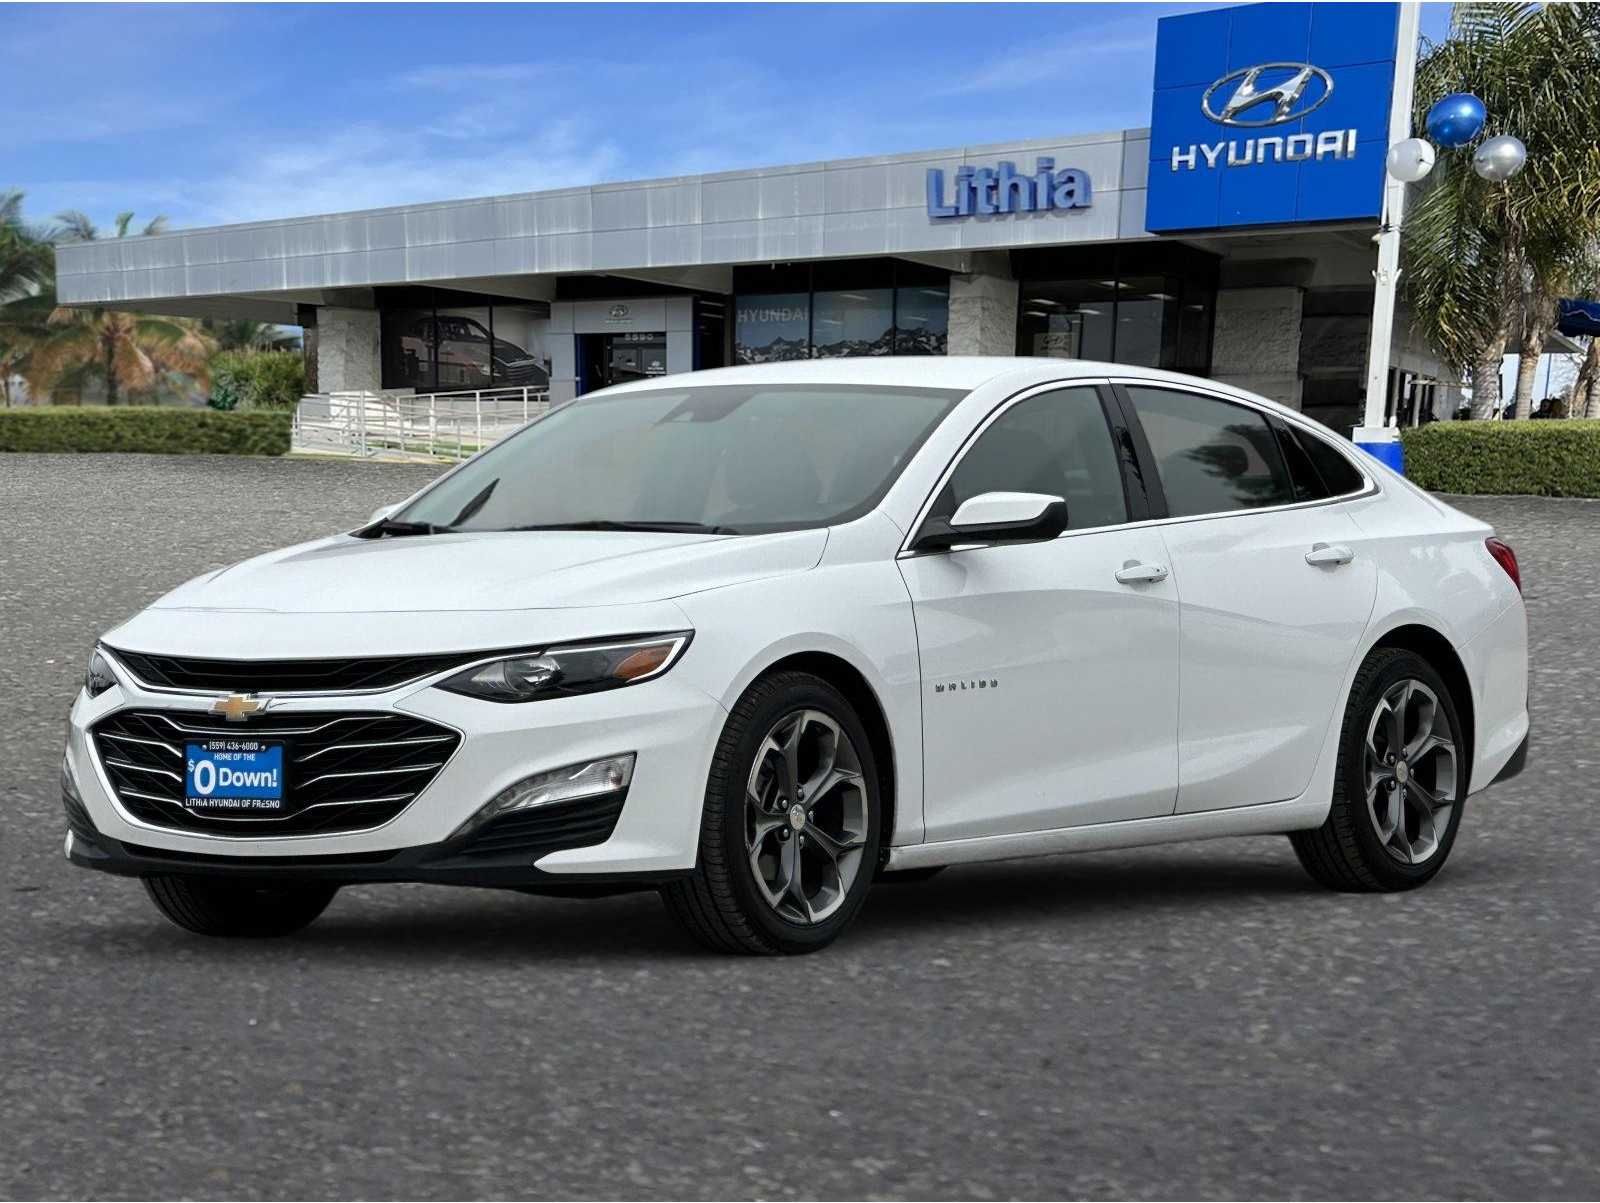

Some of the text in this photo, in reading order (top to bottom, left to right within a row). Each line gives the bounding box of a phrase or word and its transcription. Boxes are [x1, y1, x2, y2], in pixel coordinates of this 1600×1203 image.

[1171, 129, 1357, 171] HYUNDAI
[927, 157, 1092, 217] Lithia
[737, 308, 809, 322] HYUNDAI
[209, 741, 225, 750] (559)
[214, 753, 256, 761] HOME OF THE
[219, 767, 278, 787] Down!
[185, 798, 280, 809] LITHIA HYUNDAI OF FRESNO
